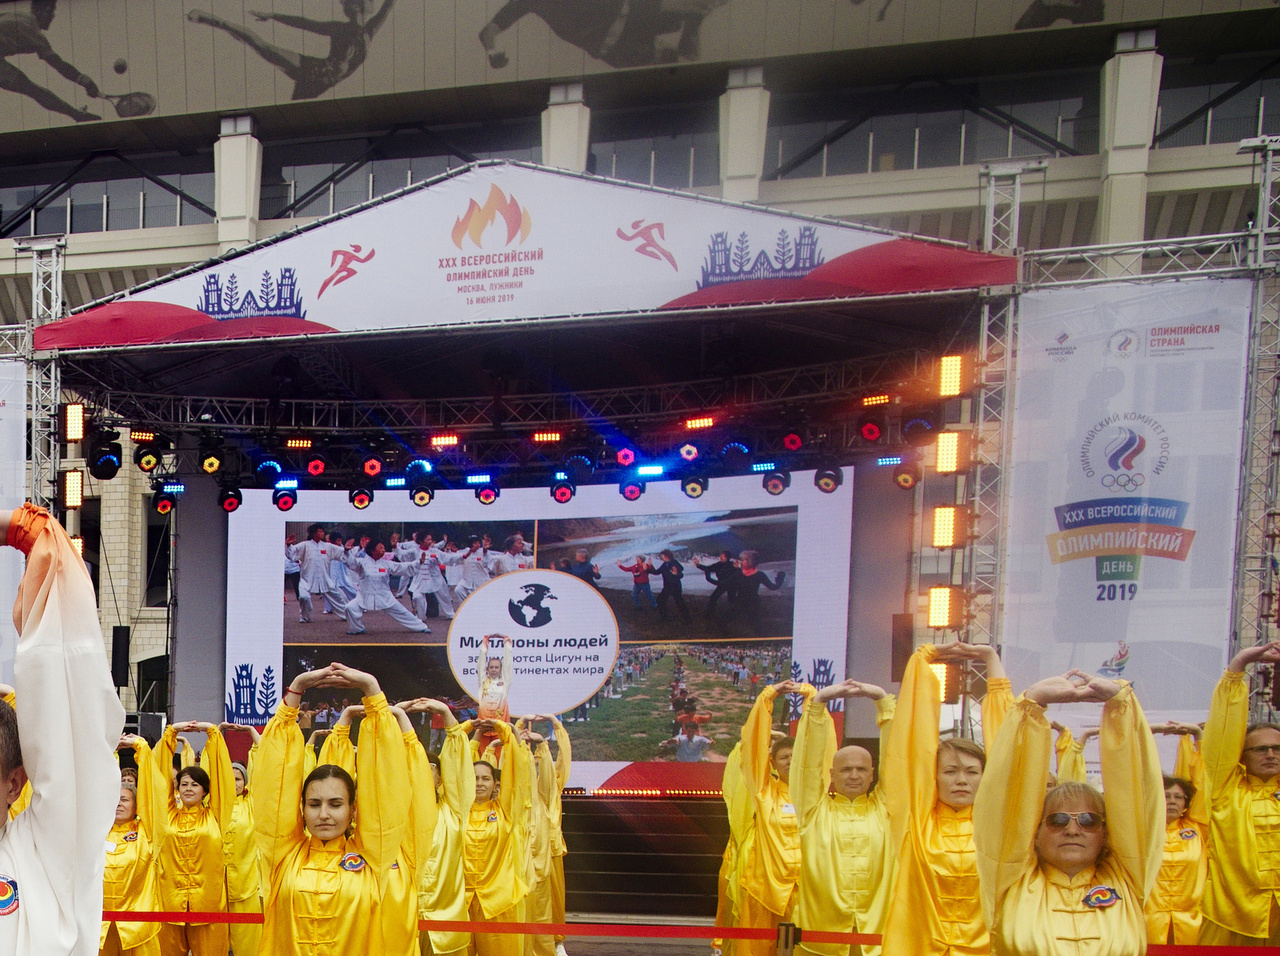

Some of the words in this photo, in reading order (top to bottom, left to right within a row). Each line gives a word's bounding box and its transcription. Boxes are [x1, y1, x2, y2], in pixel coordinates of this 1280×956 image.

[460, 248, 544, 267] ВСЕРОССИЙСКИЙ
[446, 266, 510, 282] ОЛИМПИЙСКИЙ
[512, 266, 535, 278] ДЕНЬ
[457, 284, 487, 294] МОСКВА,
[489, 281, 524, 291] ЛУЖНИКИ
[466, 297, 474, 305] 16
[475, 295, 496, 304] ИЮНЯ
[497, 293, 515, 303] 2019
[1150, 323, 1220, 337] ОЛИМПИЙСКАЯ
[1150, 338, 1186, 348] СТРАНА
[1080, 413, 1121, 478] ОЛИМПИЙСКИЙ
[1123, 412, 1166, 436] КОМИТЕТ
[1152, 436, 1171, 476] РОССИИ
[1087, 503, 1178, 520] ВСЕРОССИЙСКИЙ
[1056, 528, 1183, 556] ОЛИМПИЙСКИЙ
[1102, 561, 1135, 575] ДЕНЬ
[1096, 583, 1138, 601] 2019
[553, 634, 609, 650] людей
[545, 653, 582, 665] Цигун
[585, 654, 600, 662] на
[572, 665, 605, 676] мира
